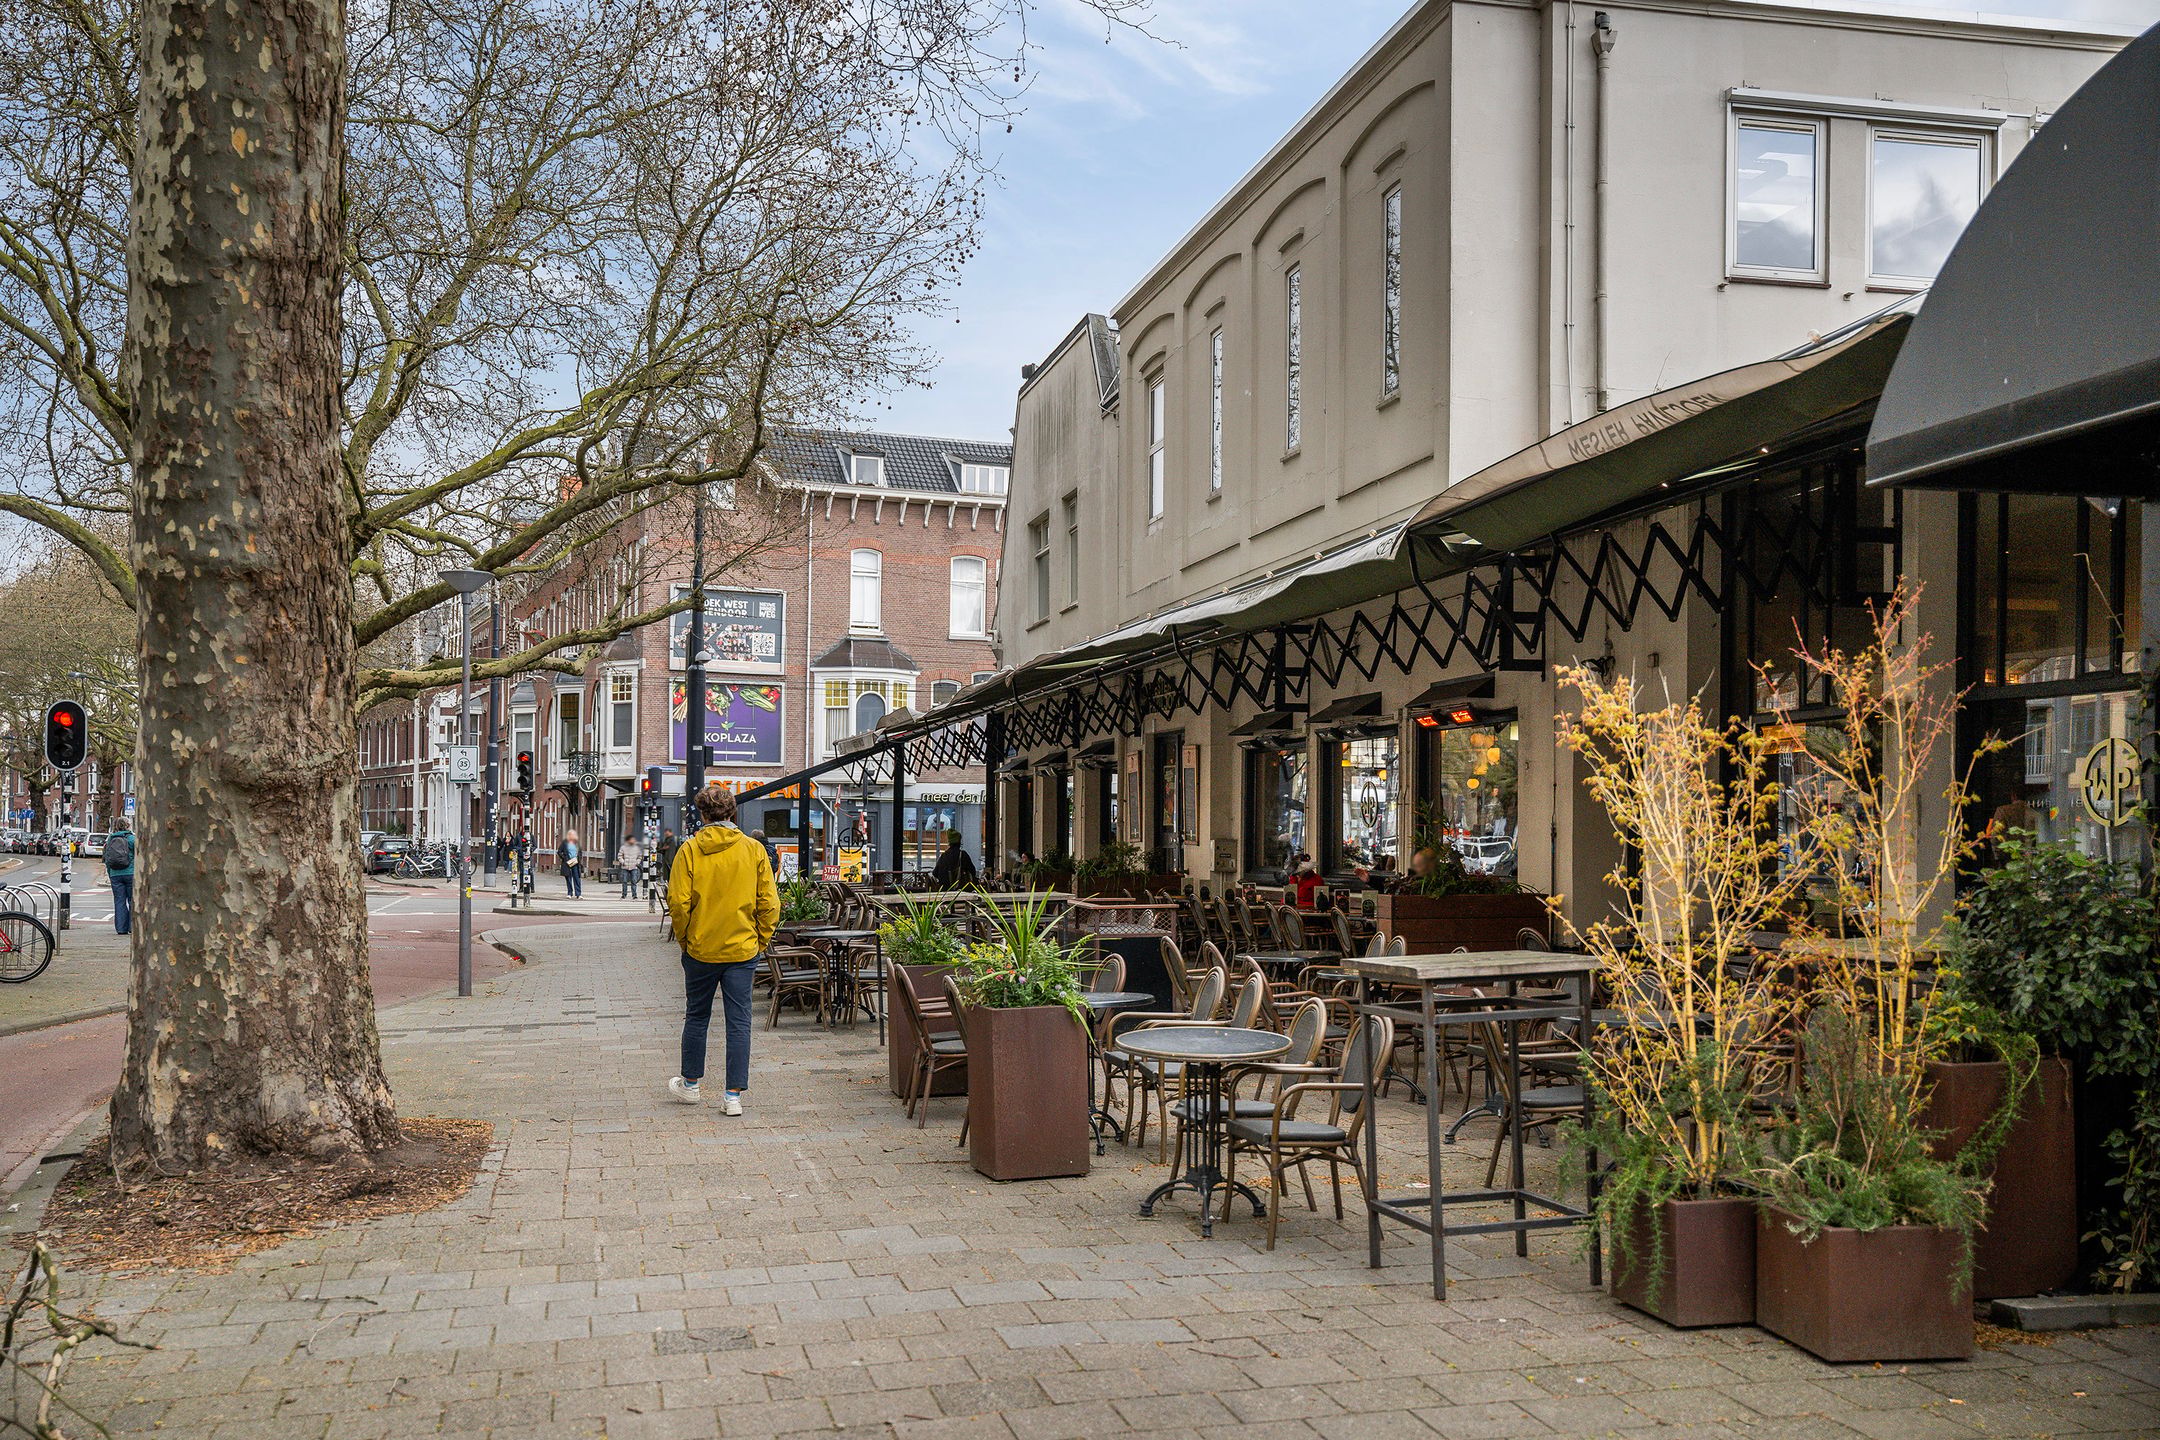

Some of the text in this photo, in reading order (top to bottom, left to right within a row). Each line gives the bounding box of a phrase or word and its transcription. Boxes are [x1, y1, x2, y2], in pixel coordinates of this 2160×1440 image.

[723, 600, 749, 609] WEST
[759, 610, 776, 619] WEG
[704, 732, 757, 743] KOPLAZA
[920, 792, 954, 803] meer
[954, 789, 980, 804] dan
